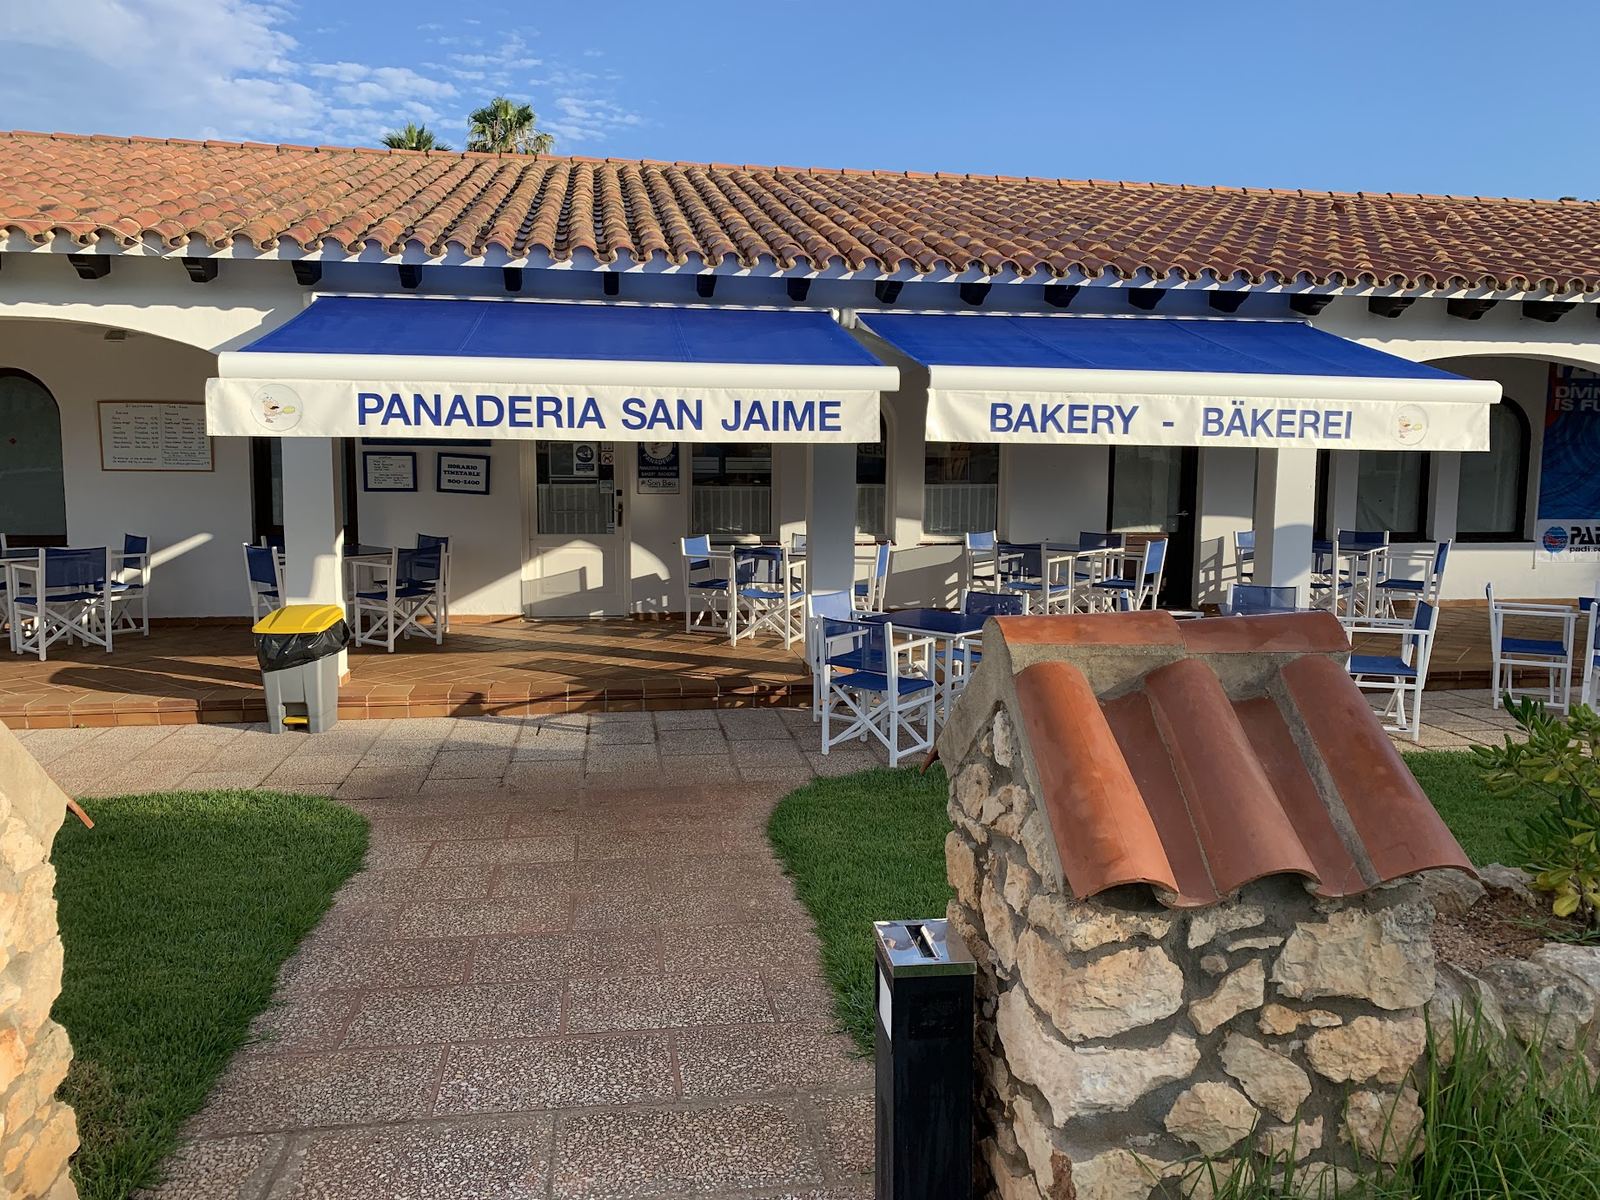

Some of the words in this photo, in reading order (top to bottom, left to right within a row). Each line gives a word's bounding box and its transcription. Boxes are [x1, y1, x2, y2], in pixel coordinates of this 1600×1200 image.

[357, 392, 607, 430] PANADERIA
[621, 397, 703, 431] SAN
[721, 399, 842, 432] JAIME
[989, 402, 1140, 435] BAKERY
[1202, 400, 1353, 440] BÄKEREI
[1554, 398, 1575, 411] IS
